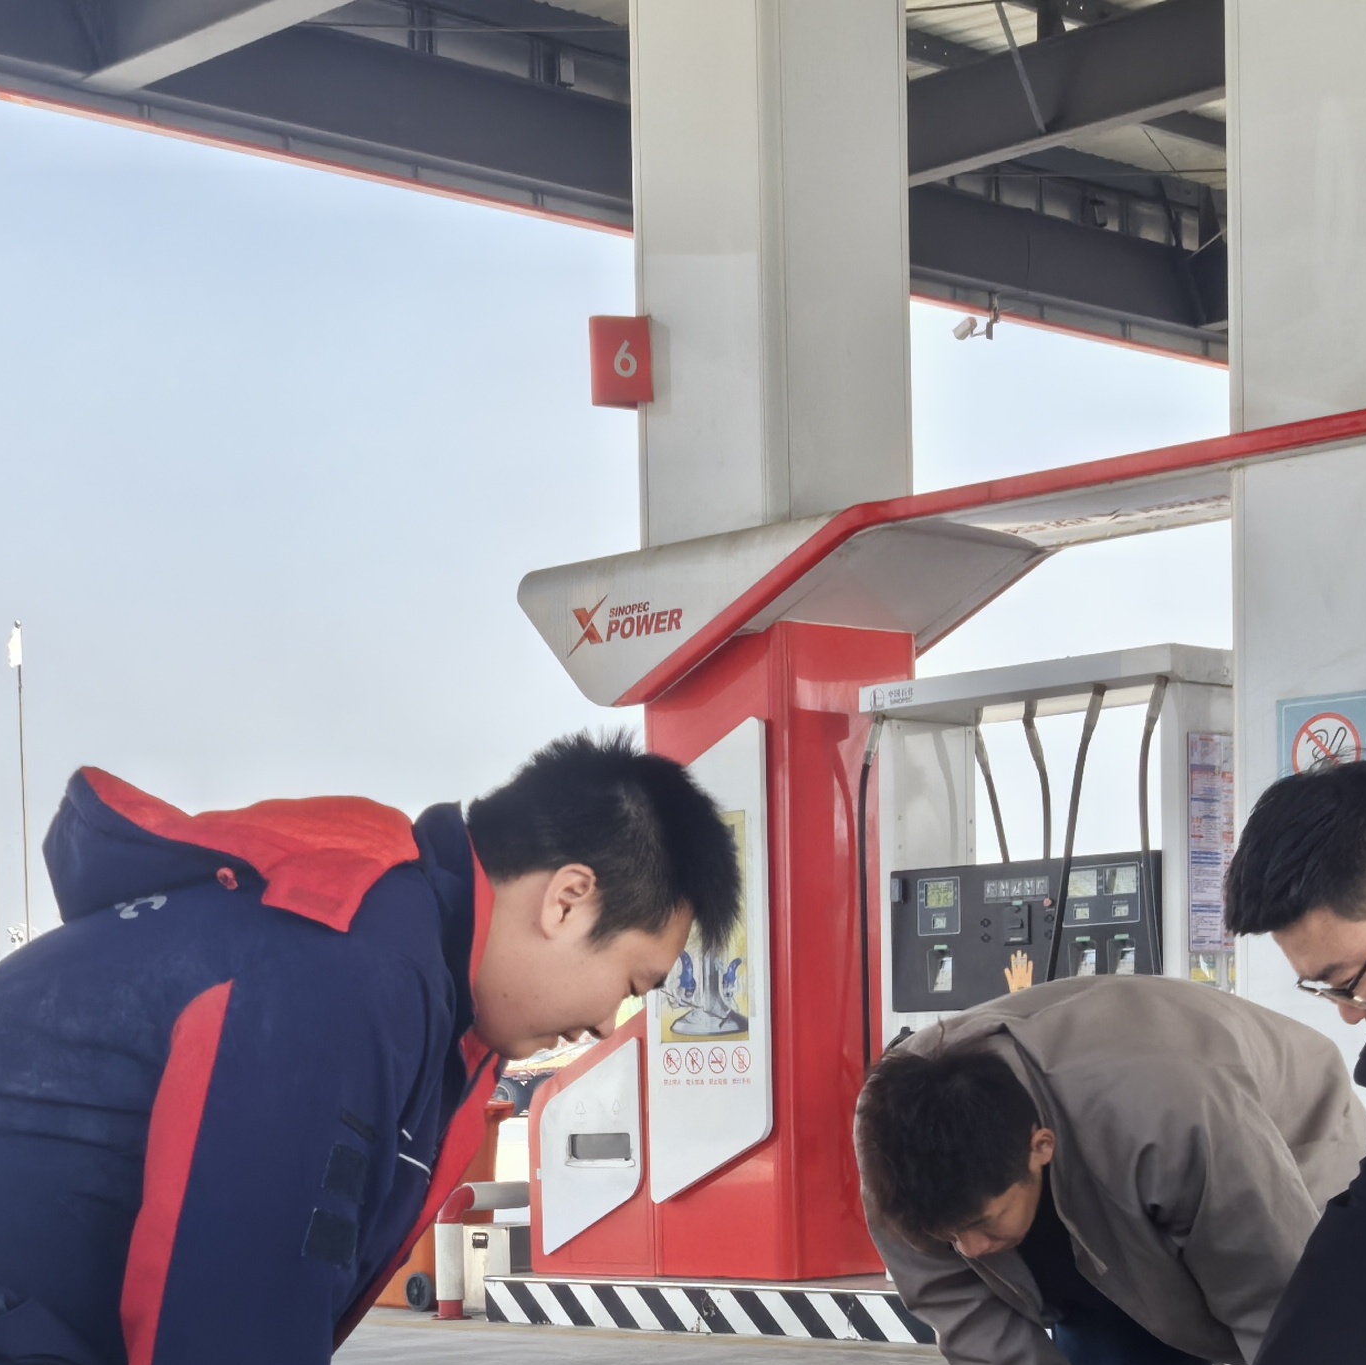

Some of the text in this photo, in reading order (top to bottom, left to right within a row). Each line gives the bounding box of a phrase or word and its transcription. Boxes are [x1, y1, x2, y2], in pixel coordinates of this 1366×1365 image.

[614, 339, 638, 378] 6
[605, 608, 683, 642] POWER
[609, 601, 650, 619] SINOPEC
